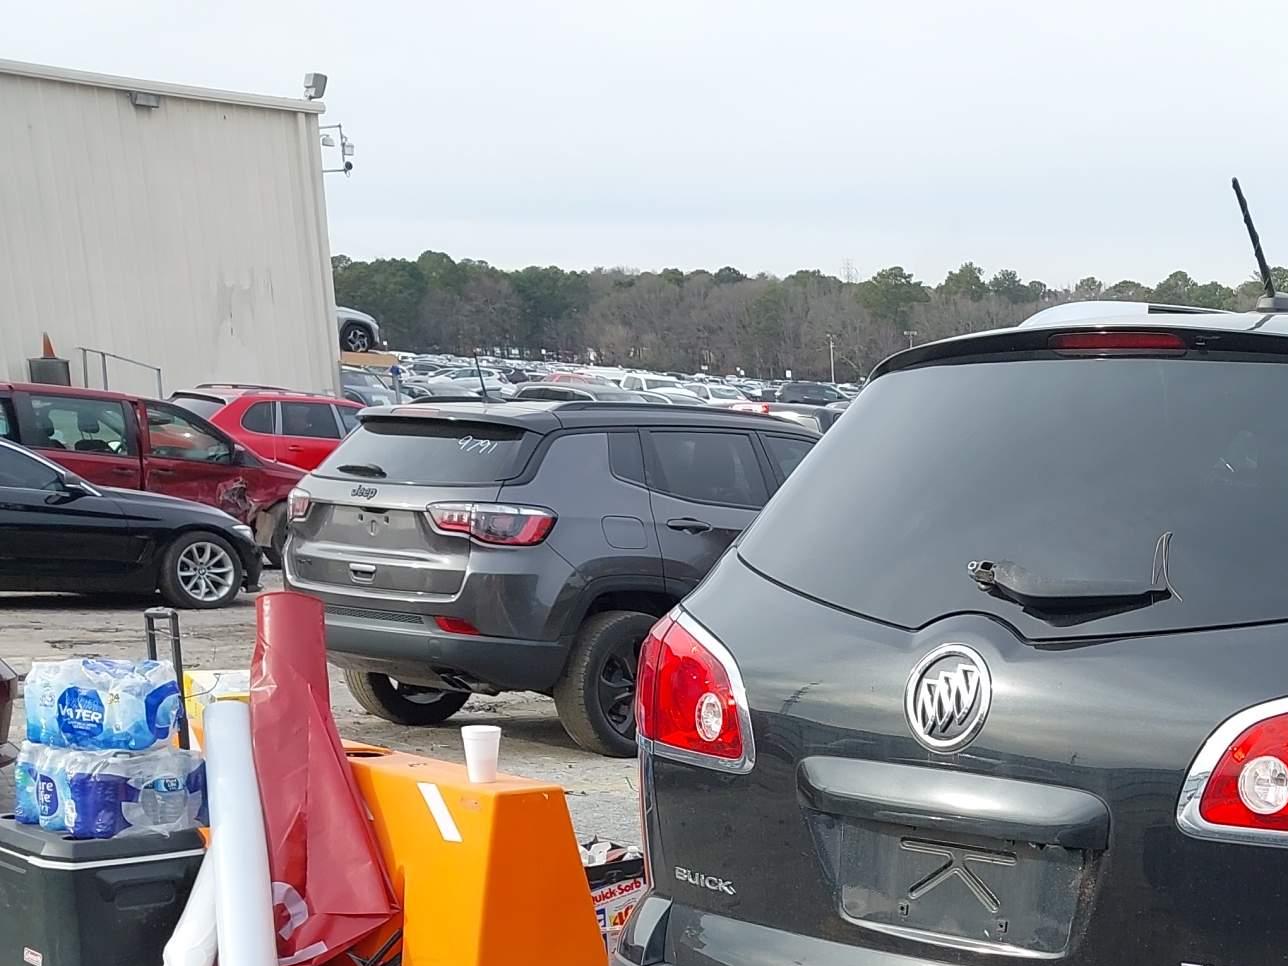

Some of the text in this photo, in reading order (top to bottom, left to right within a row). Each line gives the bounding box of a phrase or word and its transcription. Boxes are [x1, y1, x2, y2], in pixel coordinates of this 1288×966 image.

[458, 435, 498, 454] 9791
[351, 484, 378, 500] Jeep
[674, 866, 737, 895] BUICK
